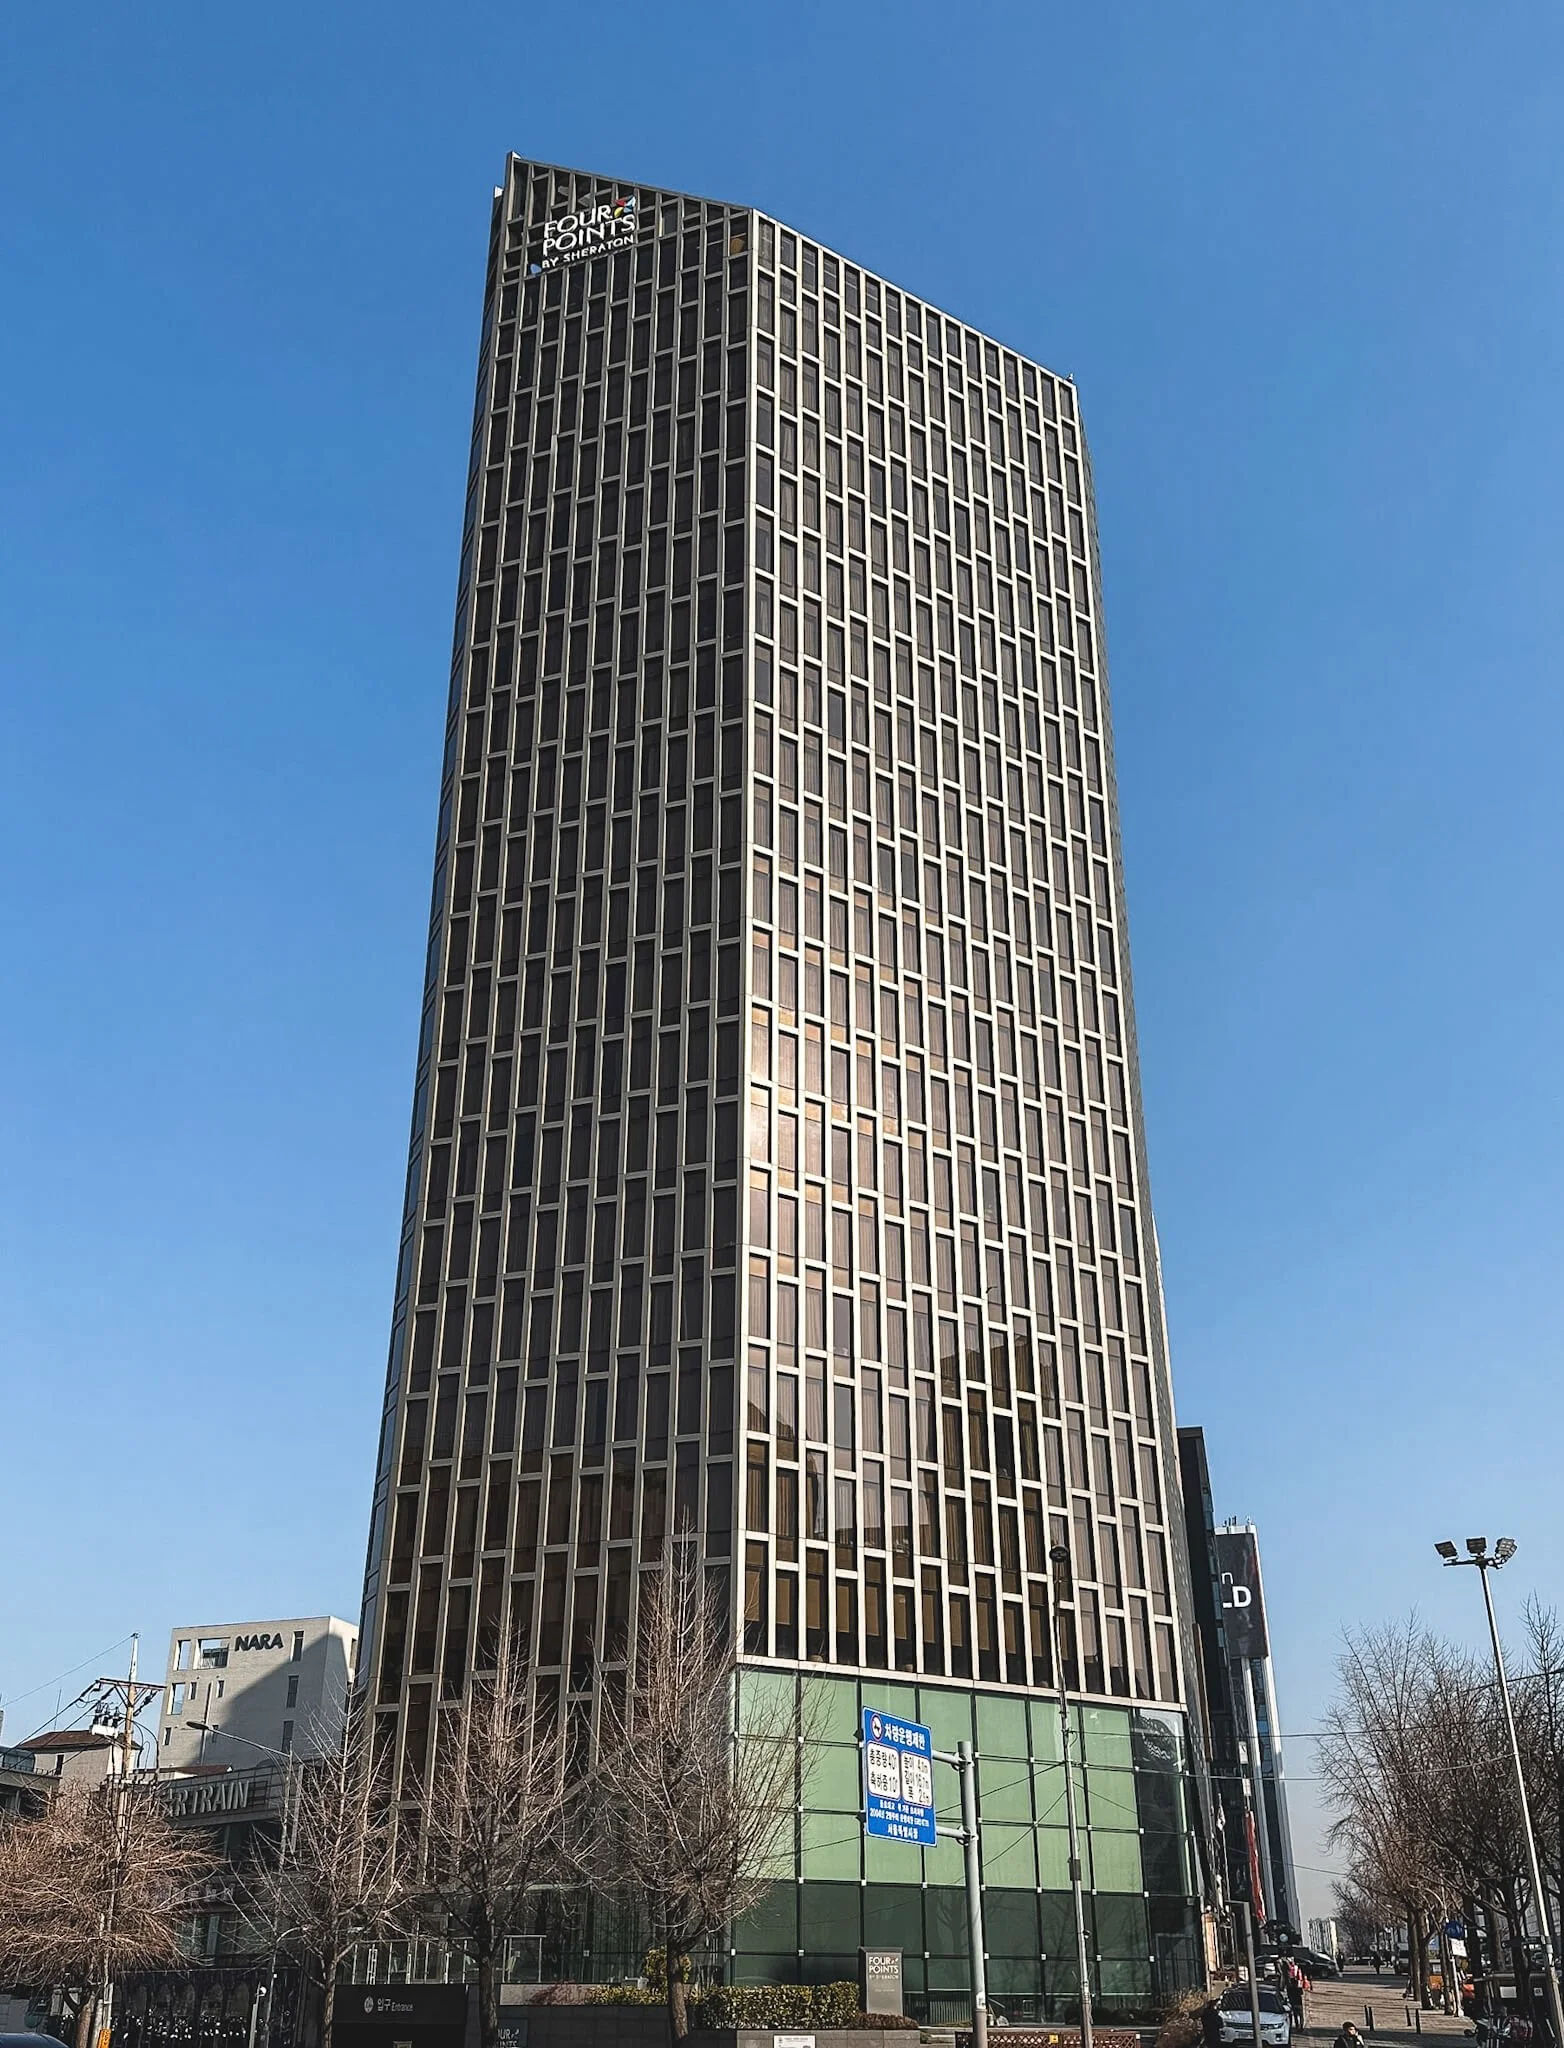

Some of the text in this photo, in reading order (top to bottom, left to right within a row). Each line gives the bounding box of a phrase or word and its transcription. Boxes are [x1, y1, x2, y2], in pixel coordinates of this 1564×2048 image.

[544, 205, 613, 239] FOUR
[543, 214, 636, 257] POINTS
[541, 234, 634, 269] BY SHERATON
[234, 1632, 284, 1652] NARA
[884, 1722, 926, 1750] 차량운행제한
[869, 1747, 887, 1768] 총중량
[869, 1956, 890, 1965] FOUR
[869, 1965, 899, 1974] POINTS
[377, 1998, 391, 2011] 입구
